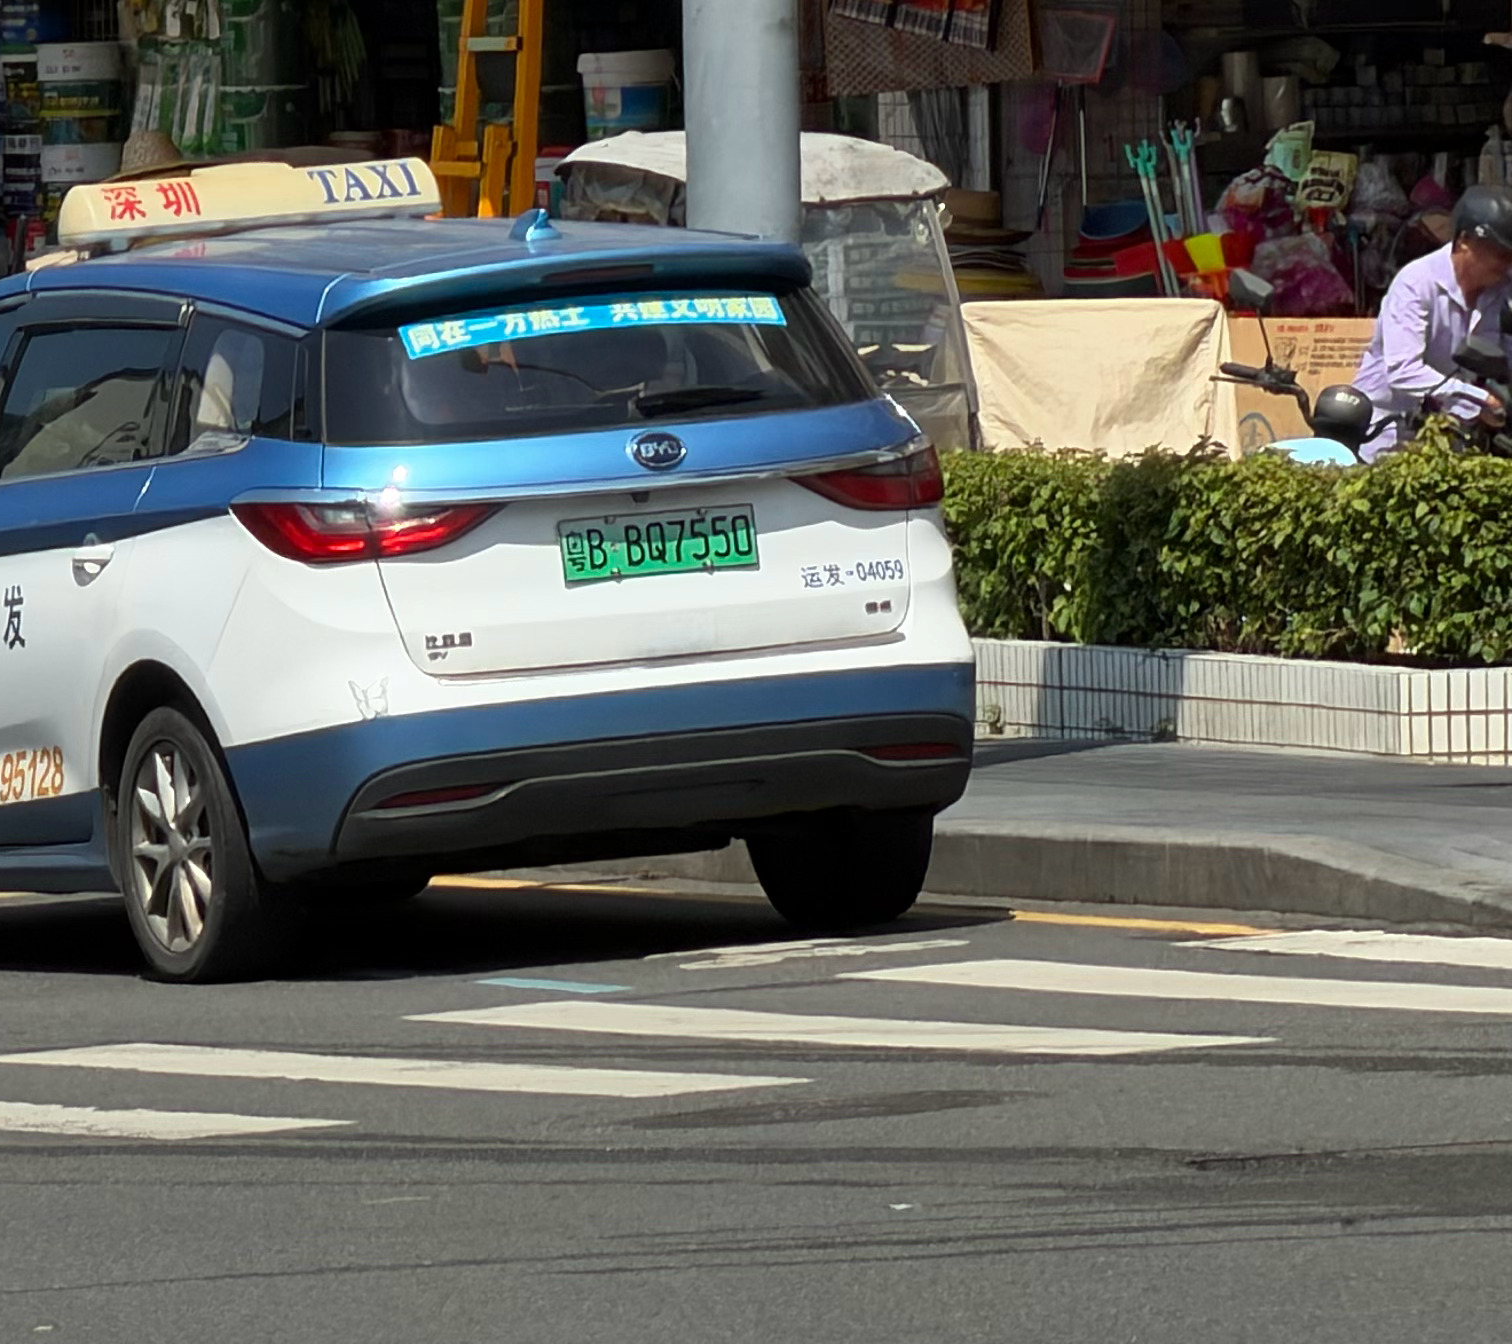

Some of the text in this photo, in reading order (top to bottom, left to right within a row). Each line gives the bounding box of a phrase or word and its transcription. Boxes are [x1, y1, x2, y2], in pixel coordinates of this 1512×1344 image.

[101, 180, 202, 222] 深圳
[307, 161, 423, 205] TAXI
[639, 438, 681, 460] BYD
[0, 744, 66, 802] 95128
